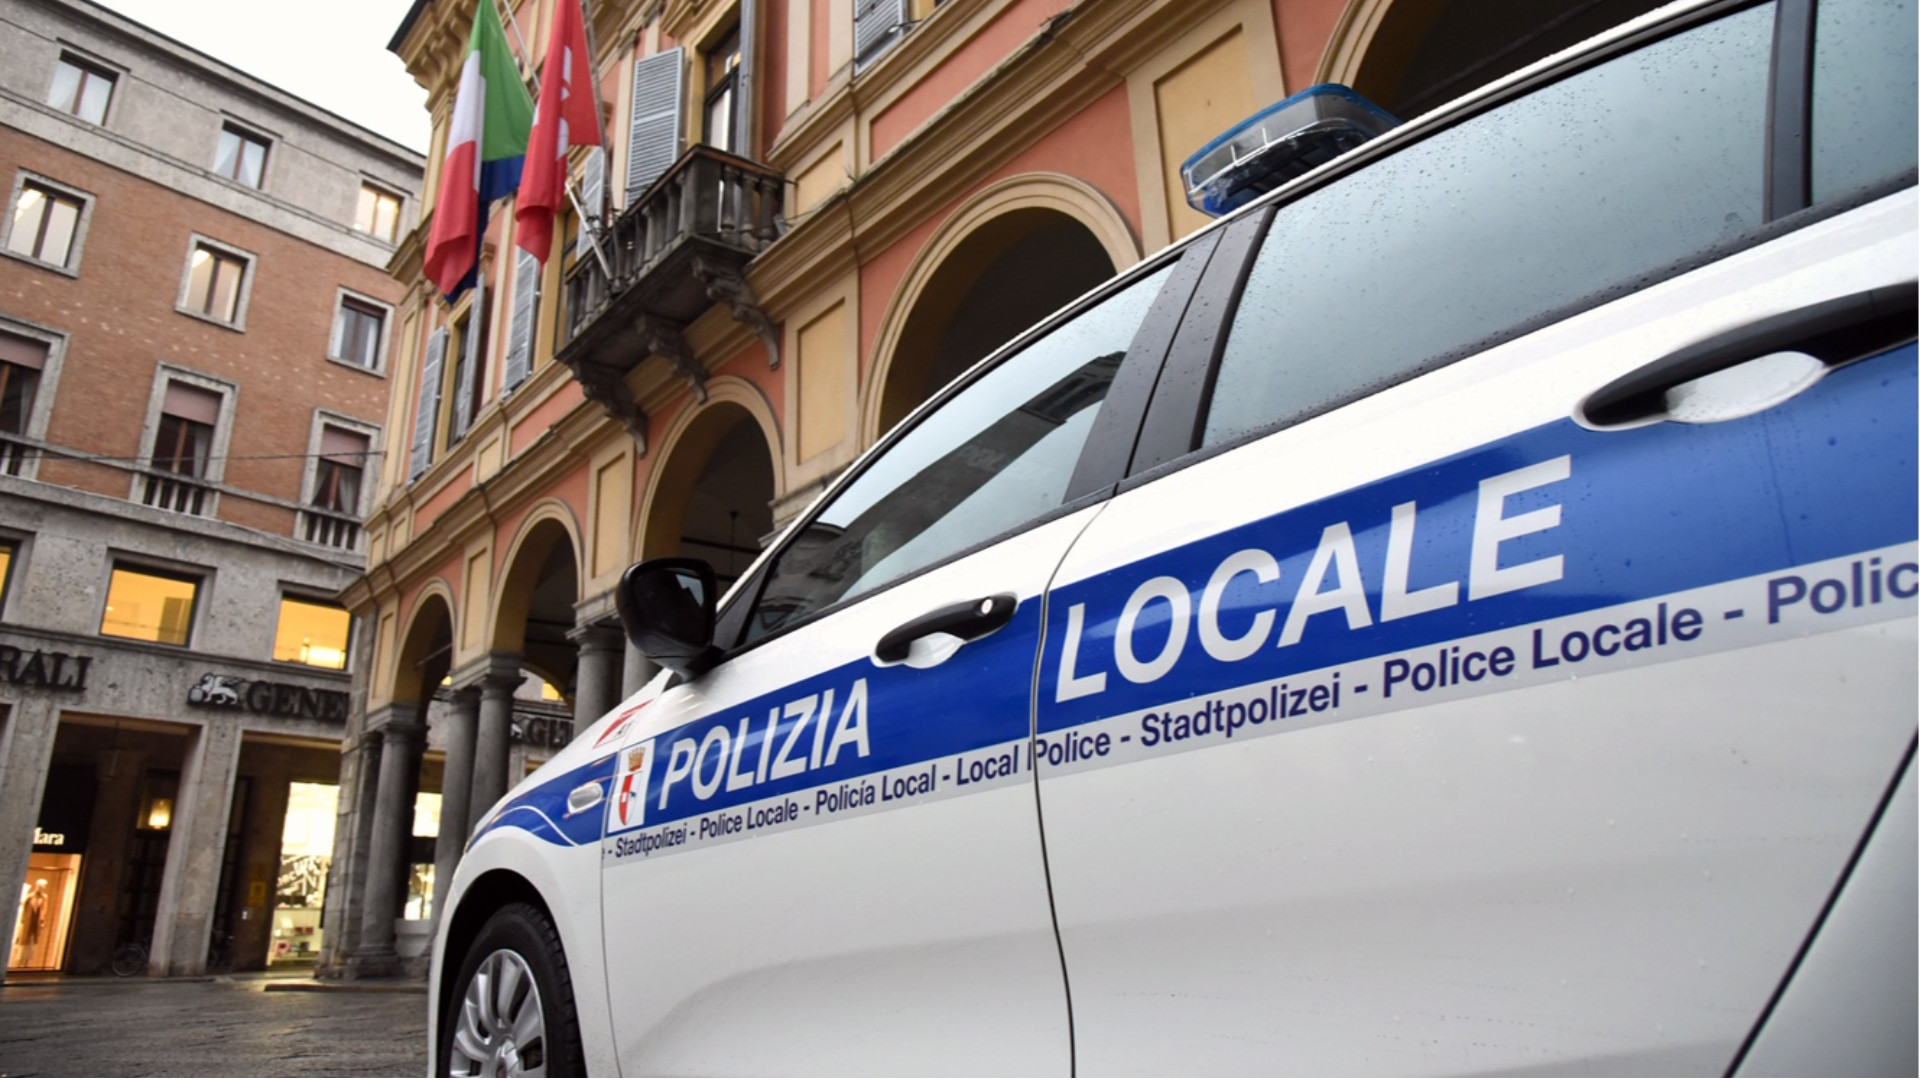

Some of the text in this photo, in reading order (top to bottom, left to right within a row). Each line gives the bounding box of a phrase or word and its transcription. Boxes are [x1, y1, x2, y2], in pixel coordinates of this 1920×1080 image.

[615, 822, 688, 858] Stadtpolizei
[699, 812, 743, 841] Police
[747, 798, 798, 830] Locale
[816, 780, 876, 815] Policía
[881, 764, 936, 801] Local
[957, 744, 1019, 785] Local
[1027, 731, 1111, 771] Police
[1141, 672, 1340, 747] Stadtpolizei
[1383, 646, 1516, 698] Police
[1532, 602, 1704, 669] Locale
[1767, 557, 1919, 624] Polic
[658, 454, 1571, 811] POLIZIA LOCALE
